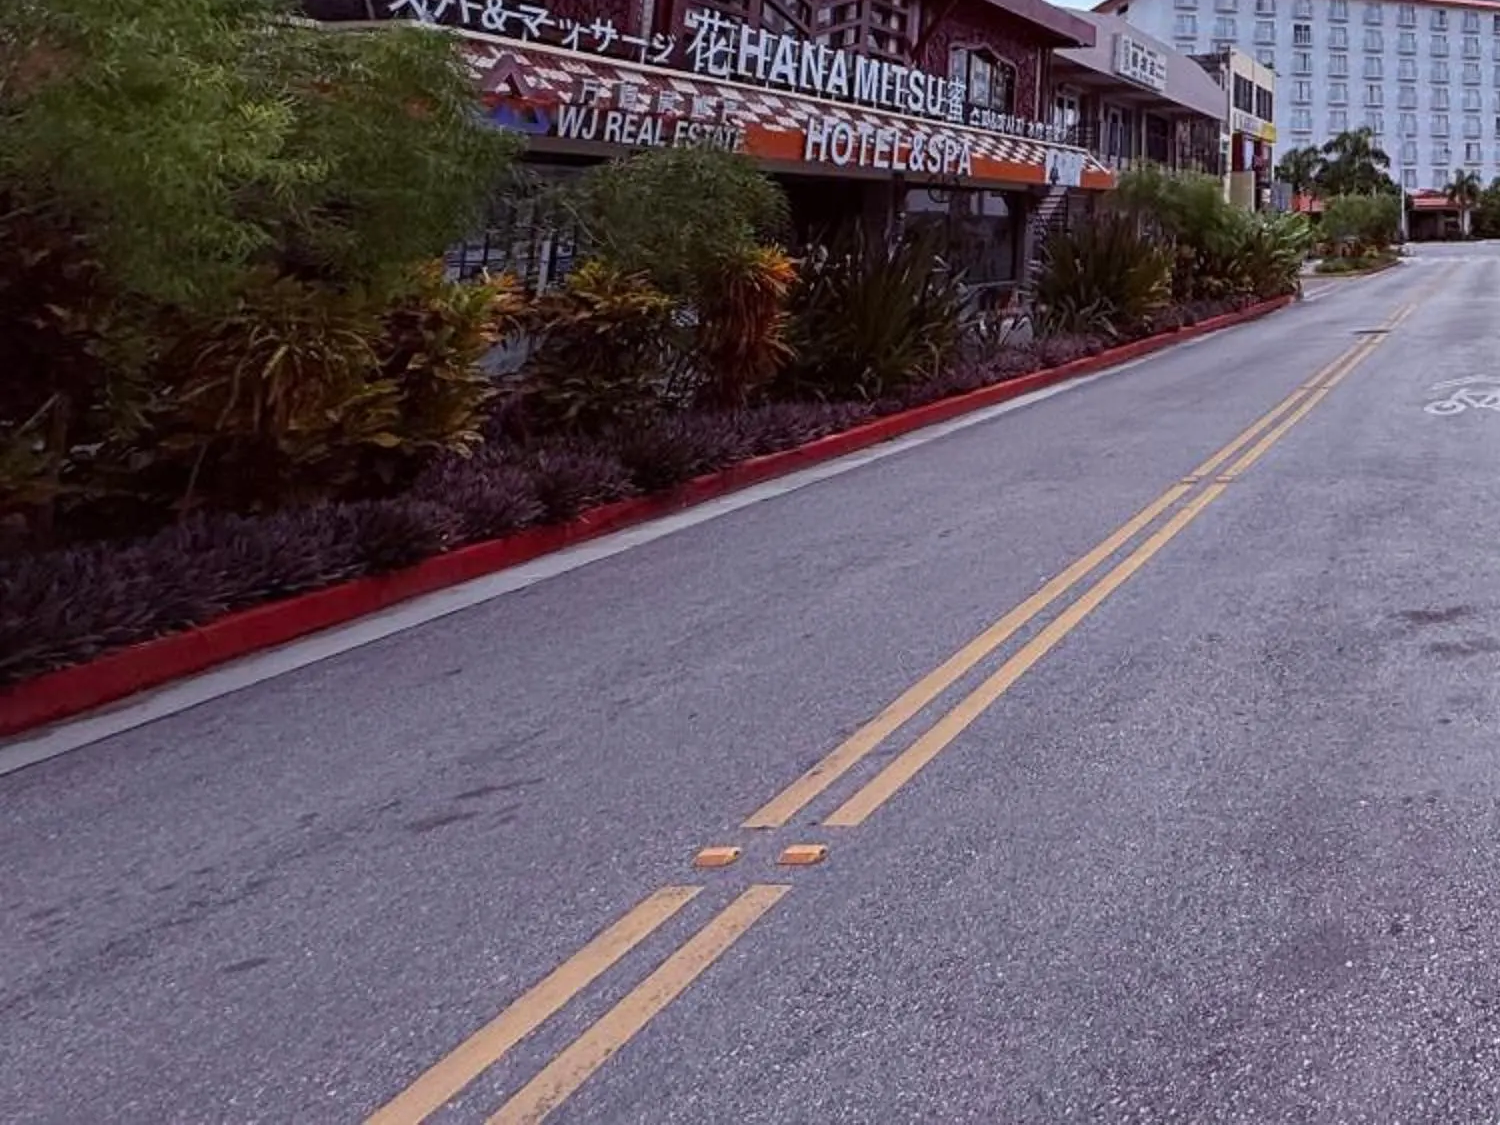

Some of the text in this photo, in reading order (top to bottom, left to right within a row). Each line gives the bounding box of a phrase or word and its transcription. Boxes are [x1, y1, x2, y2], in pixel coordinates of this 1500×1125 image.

[737, 23, 945, 116] HANAMITSU
[556, 104, 598, 140] WJ
[603, 110, 666, 148] REAL
